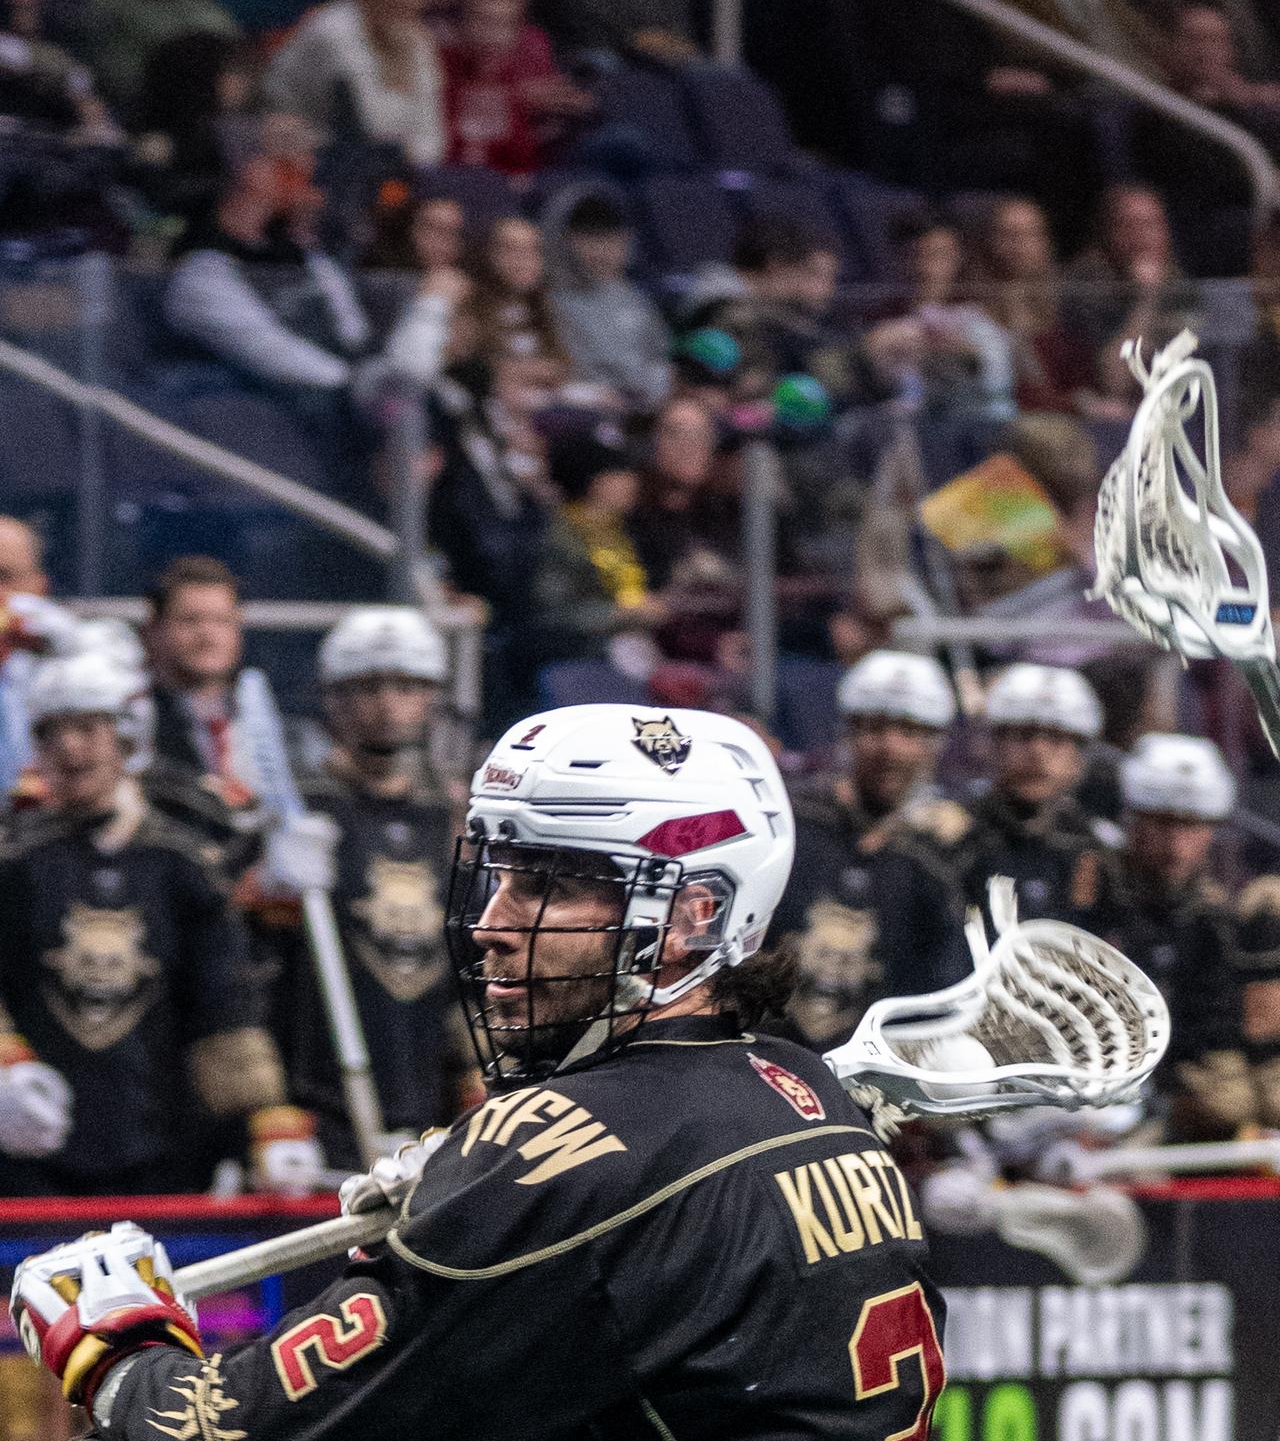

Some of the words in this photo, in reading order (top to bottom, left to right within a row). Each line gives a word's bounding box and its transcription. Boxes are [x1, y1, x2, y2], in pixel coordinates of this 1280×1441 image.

[461, 1087, 628, 1185] AFW
[775, 1149, 923, 1265] KURTZ
[271, 1292, 388, 1402] 2
[1039, 1281, 1236, 1380] PARTNER
